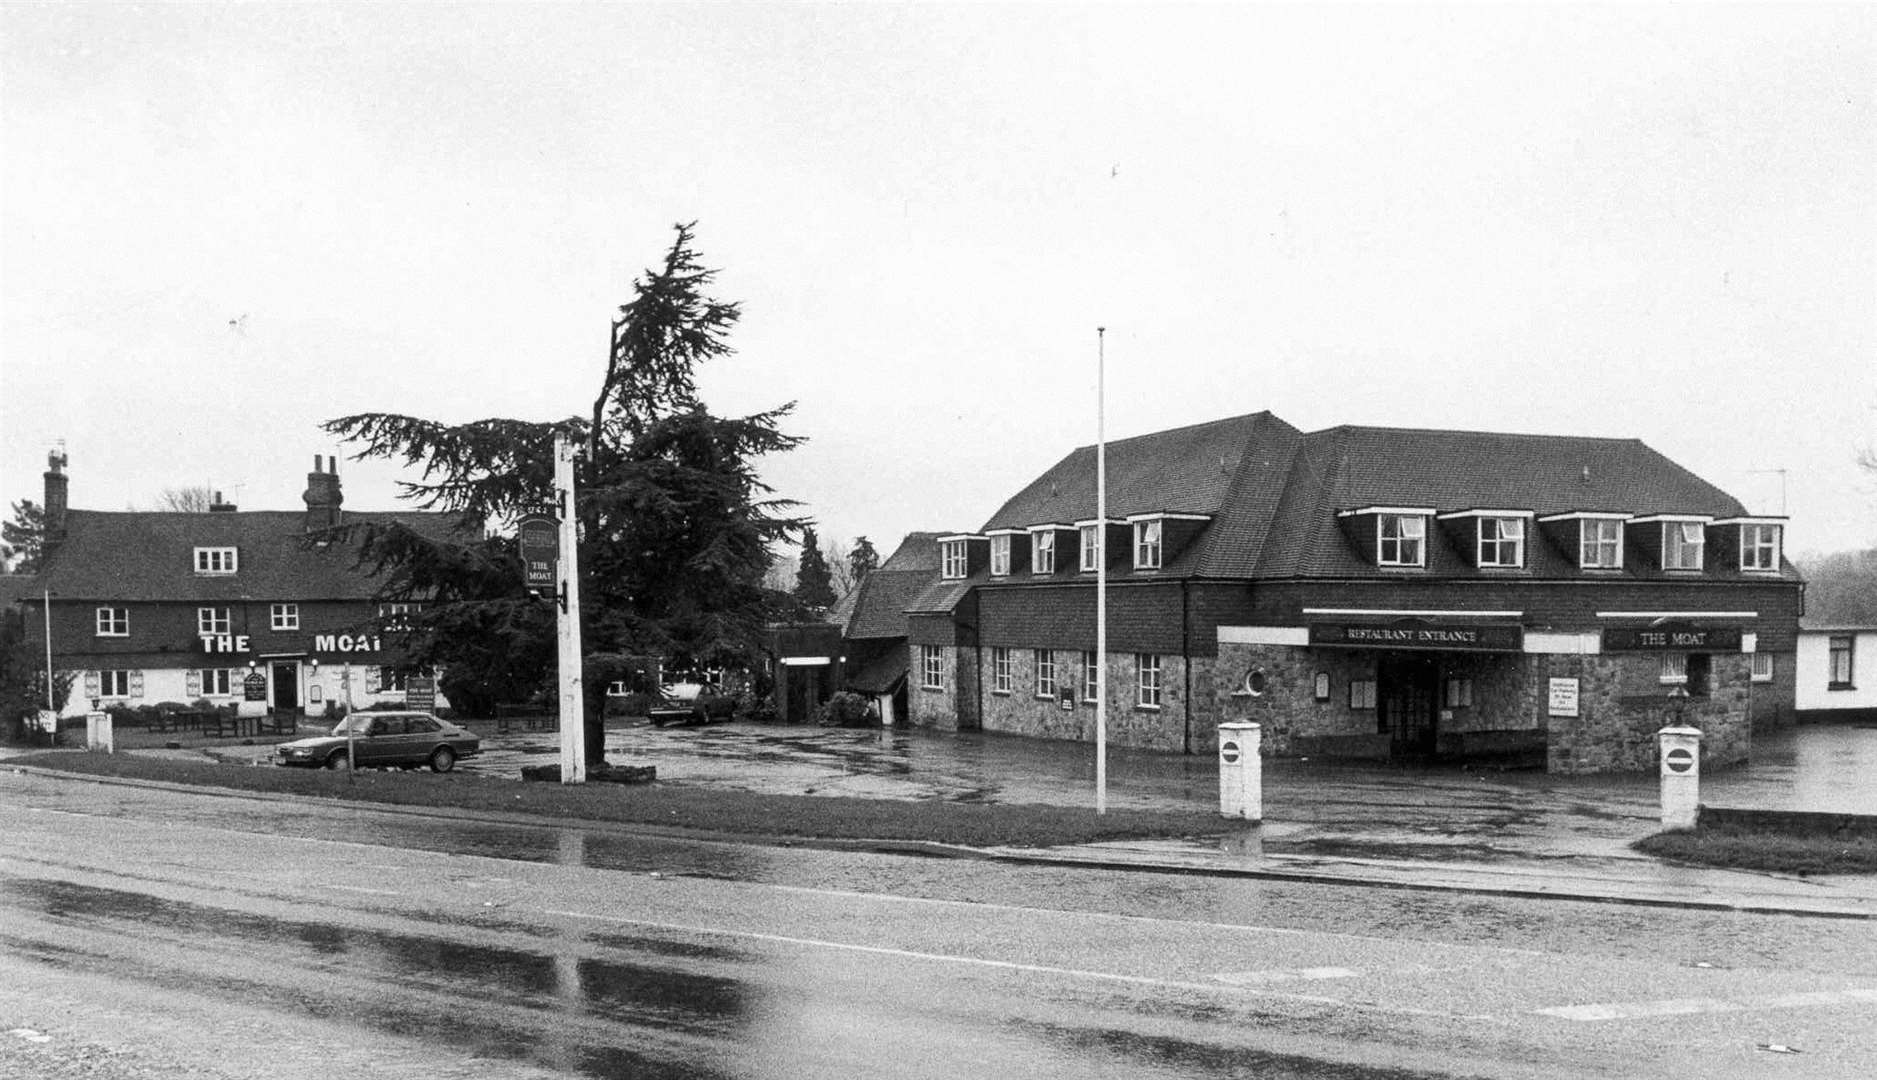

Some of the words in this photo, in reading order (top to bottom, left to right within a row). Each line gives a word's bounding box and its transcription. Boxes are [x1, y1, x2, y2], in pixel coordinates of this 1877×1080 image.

[531, 561, 548, 570] THE
[529, 572, 552, 580] MOAT
[1348, 629, 1413, 640] RESTAURANT
[1418, 630, 1476, 642] ENTRANCE
[1640, 633, 1666, 645] THE
[1672, 633, 1706, 645] MOAT
[201, 635, 250, 653] THE
